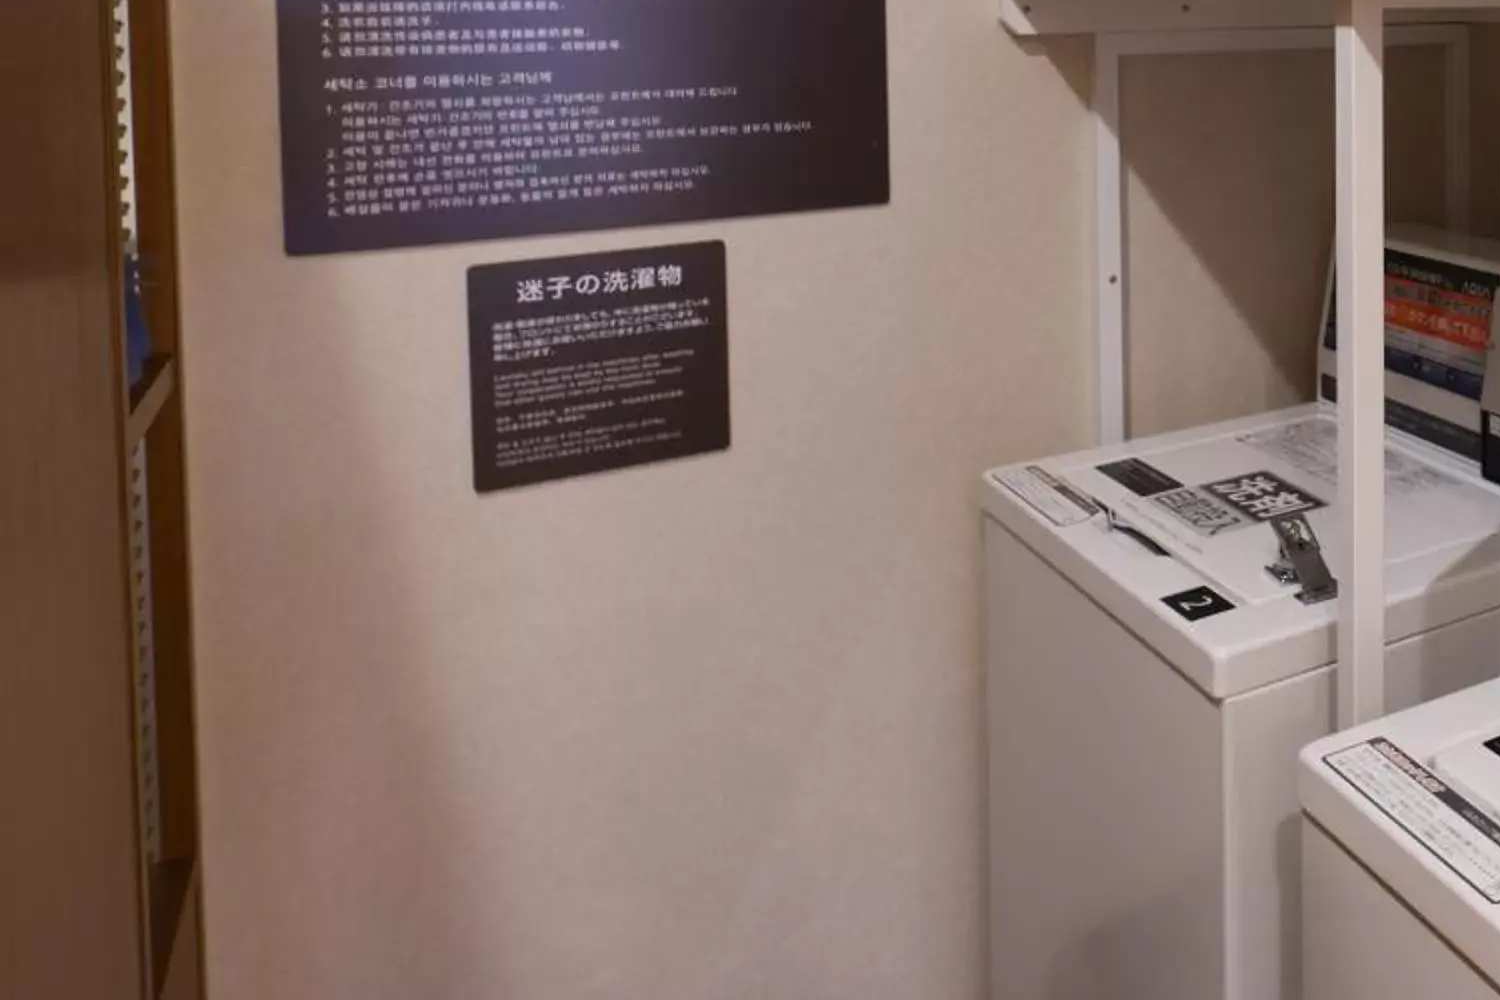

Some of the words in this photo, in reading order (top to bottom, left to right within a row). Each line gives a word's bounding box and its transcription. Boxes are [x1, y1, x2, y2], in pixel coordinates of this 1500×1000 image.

[515, 263, 683, 304] 迷子の洗濯物
[1179, 595, 1213, 612] 2
